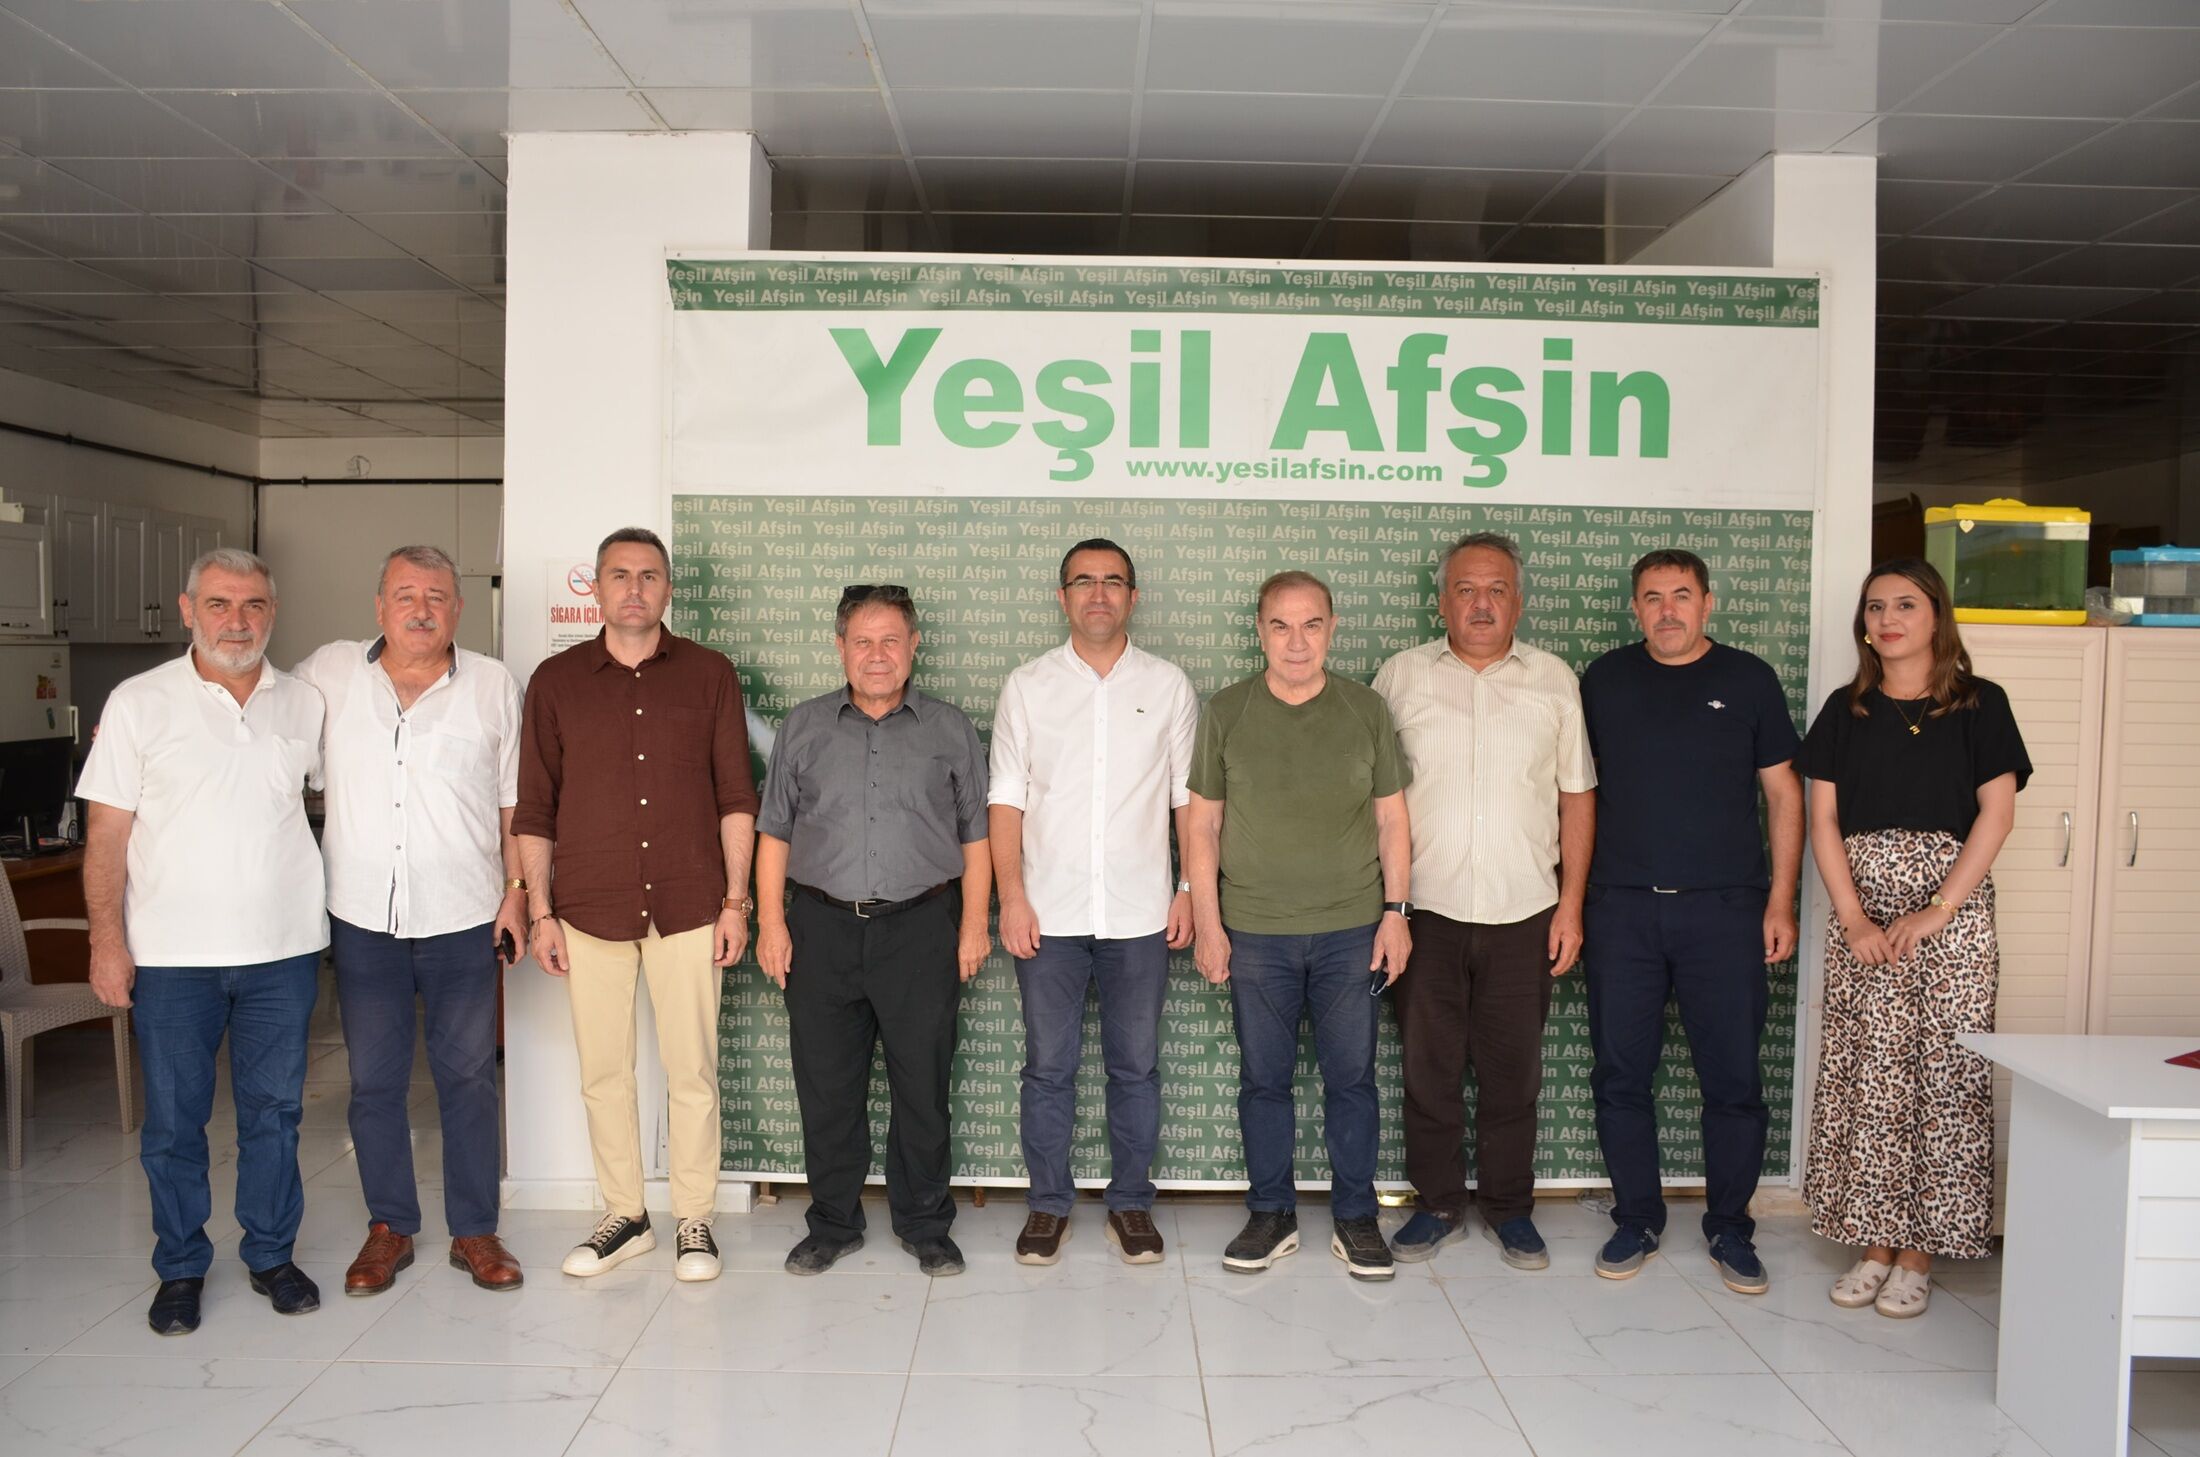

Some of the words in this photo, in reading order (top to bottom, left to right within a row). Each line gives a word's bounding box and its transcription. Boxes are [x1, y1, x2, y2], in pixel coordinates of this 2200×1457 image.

[711, 267, 756, 284] Afşin
[767, 267, 808, 284] Yeşil
[814, 267, 858, 284] Afşin
[870, 267, 910, 284] Yeşil
[917, 267, 961, 284] Afşin
[973, 267, 1013, 284] Yeşil
[1020, 268, 1064, 285] Afşin
[1076, 268, 1117, 285] Yeşil
[1123, 269, 1167, 286] Afşin
[1180, 269, 1220, 286] Yeşil
[1226, 270, 1270, 287] Afşin
[1282, 271, 1323, 288] Yeşil
[1329, 272, 1373, 289] Afşin
[1385, 274, 1425, 291] Yeşil
[1431, 275, 1475, 292] Afşin
[1486, 276, 1527, 293] Yeşil
[1532, 277, 1576, 294] Afşin
[1587, 279, 1627, 296] Yeşil
[1632, 281, 1677, 298] Afşin
[1687, 282, 1727, 299] Yeşil
[1732, 284, 1776, 301] Afşin
[714, 290, 754, 307] Yeşil
[760, 289, 805, 306] Afşin
[816, 289, 857, 306] Yeşil
[863, 289, 907, 306] Afşin
[919, 289, 960, 306] Yeşil
[966, 289, 1010, 306] Afşin
[1023, 290, 1063, 307] Yeşil
[1069, 290, 1114, 307] Afşin
[1126, 291, 1166, 308] Yeşil
[1172, 291, 1217, 308] Afşin
[1229, 292, 1269, 309] Yeşil
[1275, 293, 1320, 310] Afşin
[1332, 294, 1372, 311] Yeşil
[1378, 296, 1422, 313] Afşin
[1433, 297, 1474, 314] Yeşil
[1479, 298, 1524, 315] Afşin
[1535, 299, 1575, 316] Yeşil
[1580, 301, 1624, 318] Afşin
[1635, 302, 1675, 319] Yeşil
[1680, 304, 1724, 321] Afşin
[1734, 305, 1774, 322] Yeşil
[828, 327, 1212, 482] Yeşil
[1269, 332, 1671, 488] Afşin
[1126, 458, 1443, 484] www.yesilafsin.com
[709, 499, 753, 516] Afşin
[765, 499, 805, 516] Yeşil
[811, 499, 855, 516] Afşin
[867, 500, 908, 517] Yeşil
[914, 500, 958, 517] Afşin
[970, 500, 1010, 517] Yeşil
[1017, 501, 1061, 518] Afşin
[1073, 501, 1114, 518] Yeşil
[1120, 502, 1164, 519] Afşin
[1176, 502, 1217, 519] Yeşil
[1223, 503, 1267, 520] Afşin
[1279, 504, 1320, 521] Yeşil
[1325, 504, 1370, 521] Afşin
[1381, 506, 1422, 523] Yeşil
[1427, 506, 1472, 523] Afşin
[1483, 507, 1523, 524] Yeşil
[1528, 508, 1572, 525] Afşin
[1583, 510, 1623, 527] Yeşil
[1628, 511, 1672, 528] Afşin
[1682, 512, 1722, 529] Yeşil
[1727, 513, 1771, 530] Afşin
[711, 521, 752, 538] Yeşil
[758, 521, 802, 538] Afşin
[814, 521, 854, 538] Yeşil
[860, 522, 904, 539] Afşin
[916, 522, 957, 539] Yeşil
[963, 522, 1007, 539] Afşin
[1019, 522, 1060, 539] Yeşil
[1123, 524, 1163, 541] Yeşil
[1169, 524, 1213, 541] Afşin
[1226, 525, 1266, 542] Yeşil
[1272, 526, 1316, 543] Afşin
[1328, 526, 1368, 543] Yeşil
[1374, 527, 1418, 544] Afşin
[1530, 530, 1571, 547] Yeşil
[1575, 532, 1620, 549] Afşin
[1630, 533, 1670, 550] Yeşil
[1730, 534, 1770, 551] Yeşil
[764, 542, 805, 559] Yeşil
[810, 543, 855, 560] Afşin
[867, 543, 907, 560] Yeşil
[913, 543, 957, 560] Afşin
[969, 544, 1010, 561] Yeşil
[1016, 544, 1060, 561] Afşin
[1176, 546, 1216, 563] Yeşil
[1222, 546, 1266, 563] Afşin
[1278, 547, 1319, 564] Yeşil
[1325, 548, 1369, 565] Afşin
[1380, 549, 1421, 566] Yeşil
[1527, 552, 1571, 569] Afşin
[1582, 553, 1622, 570] Yeşil
[1726, 556, 1771, 573] Afşin
[757, 564, 801, 581] Afşin
[813, 565, 853, 582] Yeşil
[859, 565, 904, 582] Afşin
[916, 565, 956, 582] Yeşil
[962, 566, 1007, 583] Afşin
[1168, 568, 1213, 585] Afşin
[1327, 570, 1368, 587] Yeşil
[1373, 571, 1418, 588] Afşin
[1529, 574, 1570, 591] Yeşil
[1574, 575, 1619, 592] Afşin
[1729, 577, 1769, 594] Yeşil
[763, 586, 804, 603] Yeşil
[969, 587, 1009, 604] Yeşil
[1175, 589, 1215, 606] Yeşil
[1380, 592, 1420, 609] Yeşil
[1526, 595, 1570, 612] Afşin
[1581, 596, 1621, 613] Yeşil
[1726, 598, 1770, 615] Afşin
[551, 604, 582, 624] SİGARA
[756, 607, 800, 624] Afşin
[962, 609, 1006, 626] Afşin
[1168, 611, 1212, 628] Afşin
[1372, 614, 1417, 631] Afşin
[1528, 617, 1569, 634] Yeşil
[1573, 618, 1618, 635] Afşin
[1728, 620, 1769, 637] Yeşil
[763, 629, 803, 646] Yeşil
[968, 631, 1009, 648] Yeşil
[1174, 632, 1215, 649] Yeşil
[915, 652, 955, 669] Yeşil
[961, 653, 1005, 670] Afşin
[1326, 657, 1366, 674] Yeşil
[1162, 999, 1206, 1016] Afşin
[965, 1018, 1005, 1035] Yeşil
[1168, 1020, 1208, 1037] Yeşil
[958, 1039, 1002, 1056] Afşin
[1161, 1041, 1205, 1058] Afşin
[964, 1059, 1005, 1076] Yeşil
[1167, 1061, 1207, 1078] Yeşil
[958, 1080, 1002, 1097] Afşin
[1160, 1082, 1204, 1099] Afşin
[964, 1100, 1004, 1117] Yeşil
[1166, 1103, 1206, 1120] Yeşil
[756, 1119, 800, 1136] Afşin
[957, 1121, 1001, 1138] Afşin
[1159, 1124, 1203, 1141] Afşin
[1656, 1127, 1701, 1144] Afşin
[763, 1139, 803, 1156] Yeşil
[964, 1142, 1004, 1159] Yeşil
[1165, 1145, 1205, 1162] Yeşil
[1662, 1147, 1702, 1164] Yeşil
